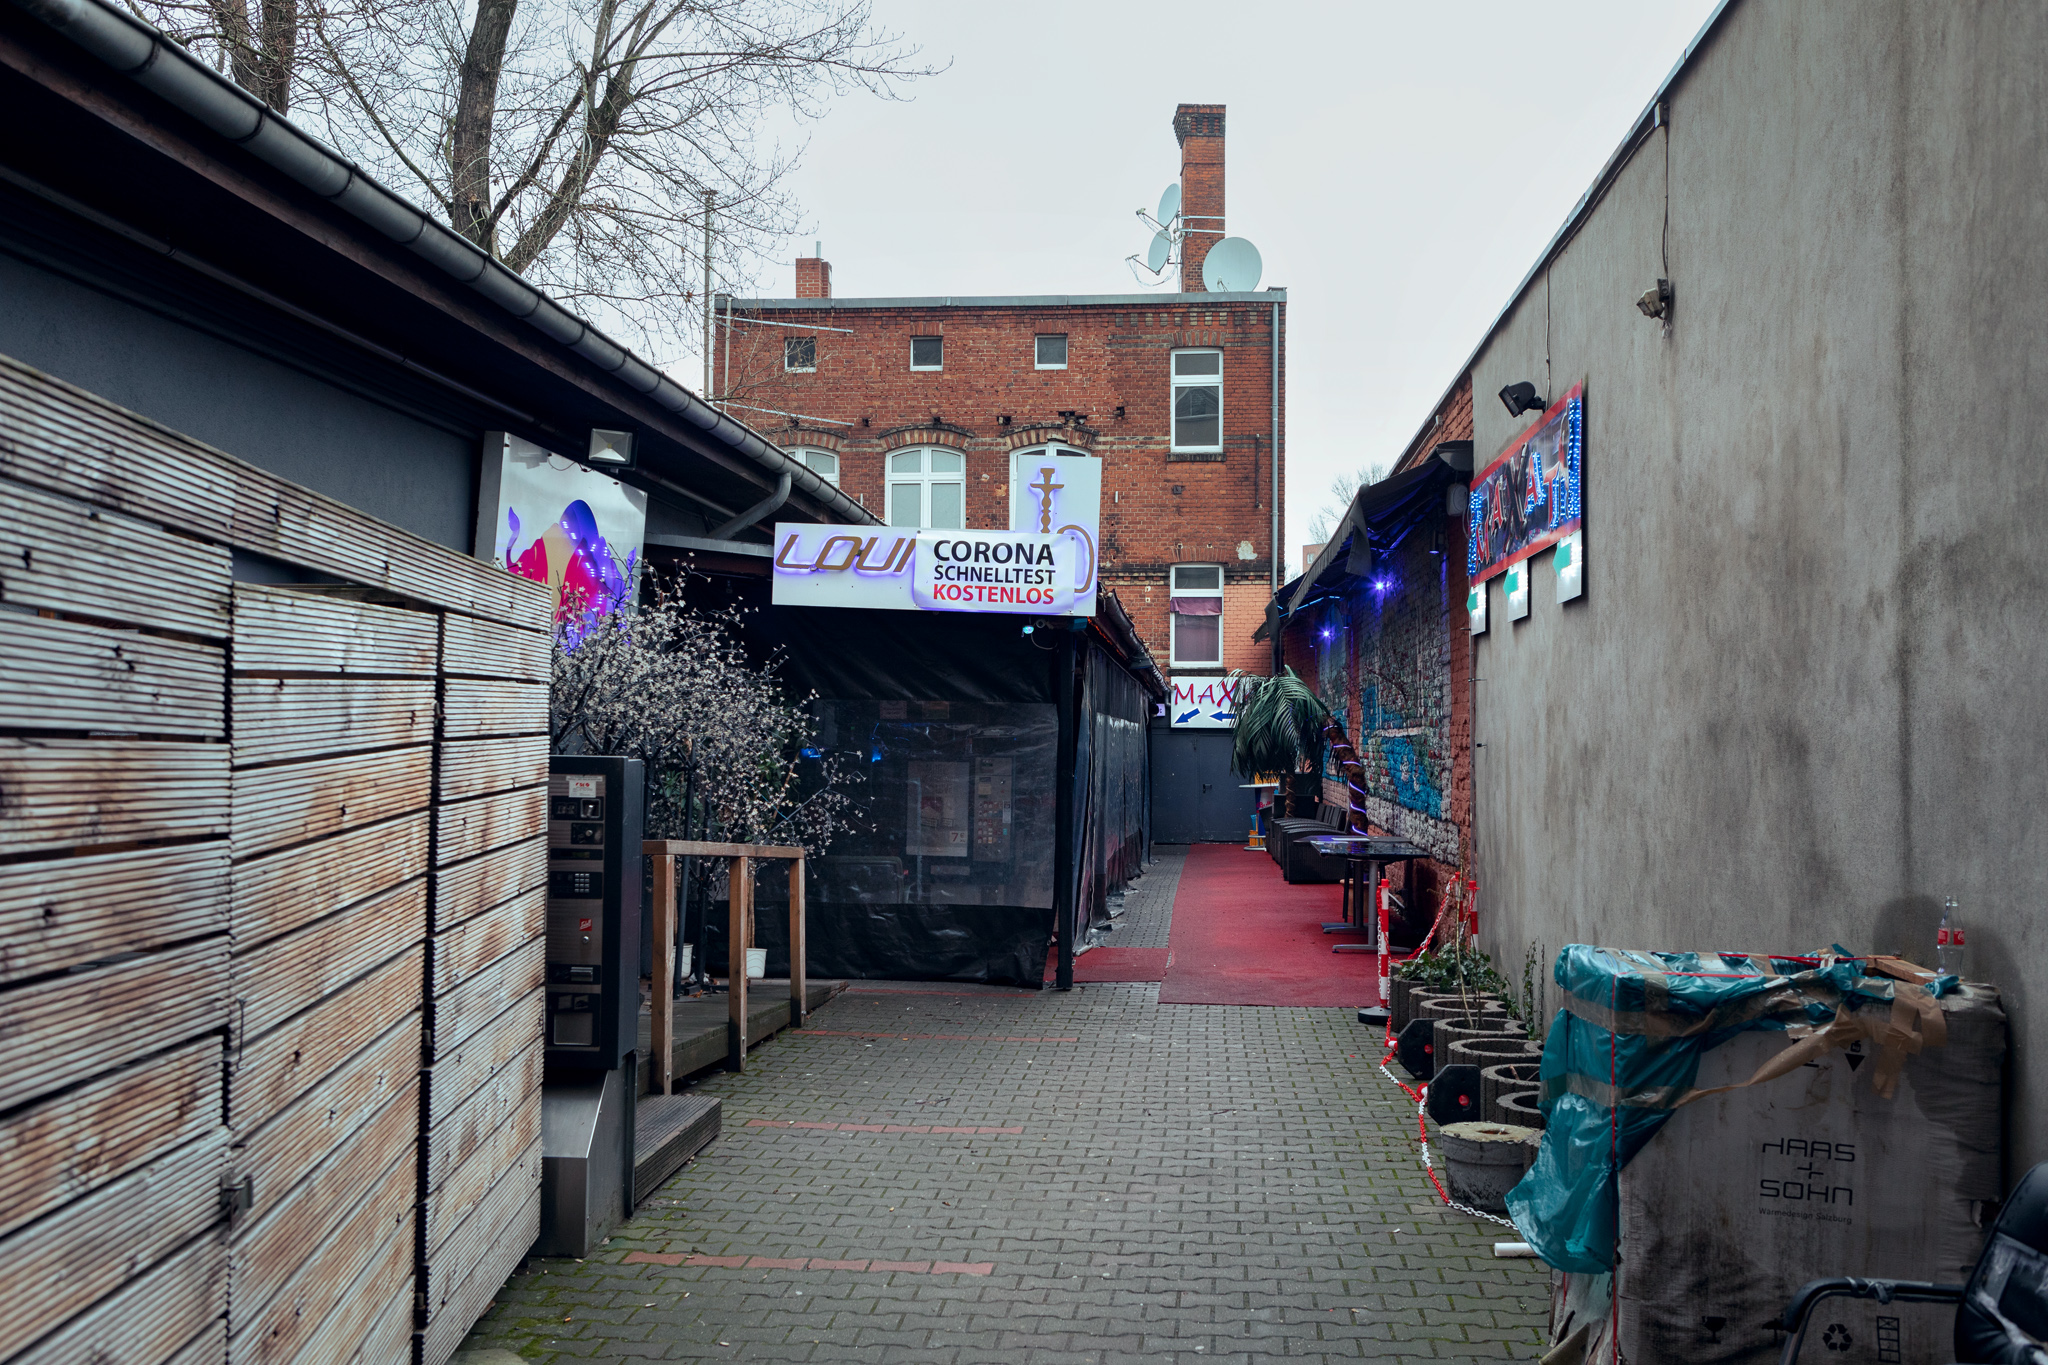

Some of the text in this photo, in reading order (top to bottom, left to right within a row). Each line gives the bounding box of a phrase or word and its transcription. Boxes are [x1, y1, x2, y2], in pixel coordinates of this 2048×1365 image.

[933, 540, 1055, 566] CORONA
[934, 565, 1056, 585] SCHNELLTEST
[933, 584, 1055, 605] KOSTENLOS
[1762, 1138, 1855, 1162] HAAS
[1760, 1179, 1853, 1206] SOHN
[1816, 1212, 1852, 1225] Salzburg
